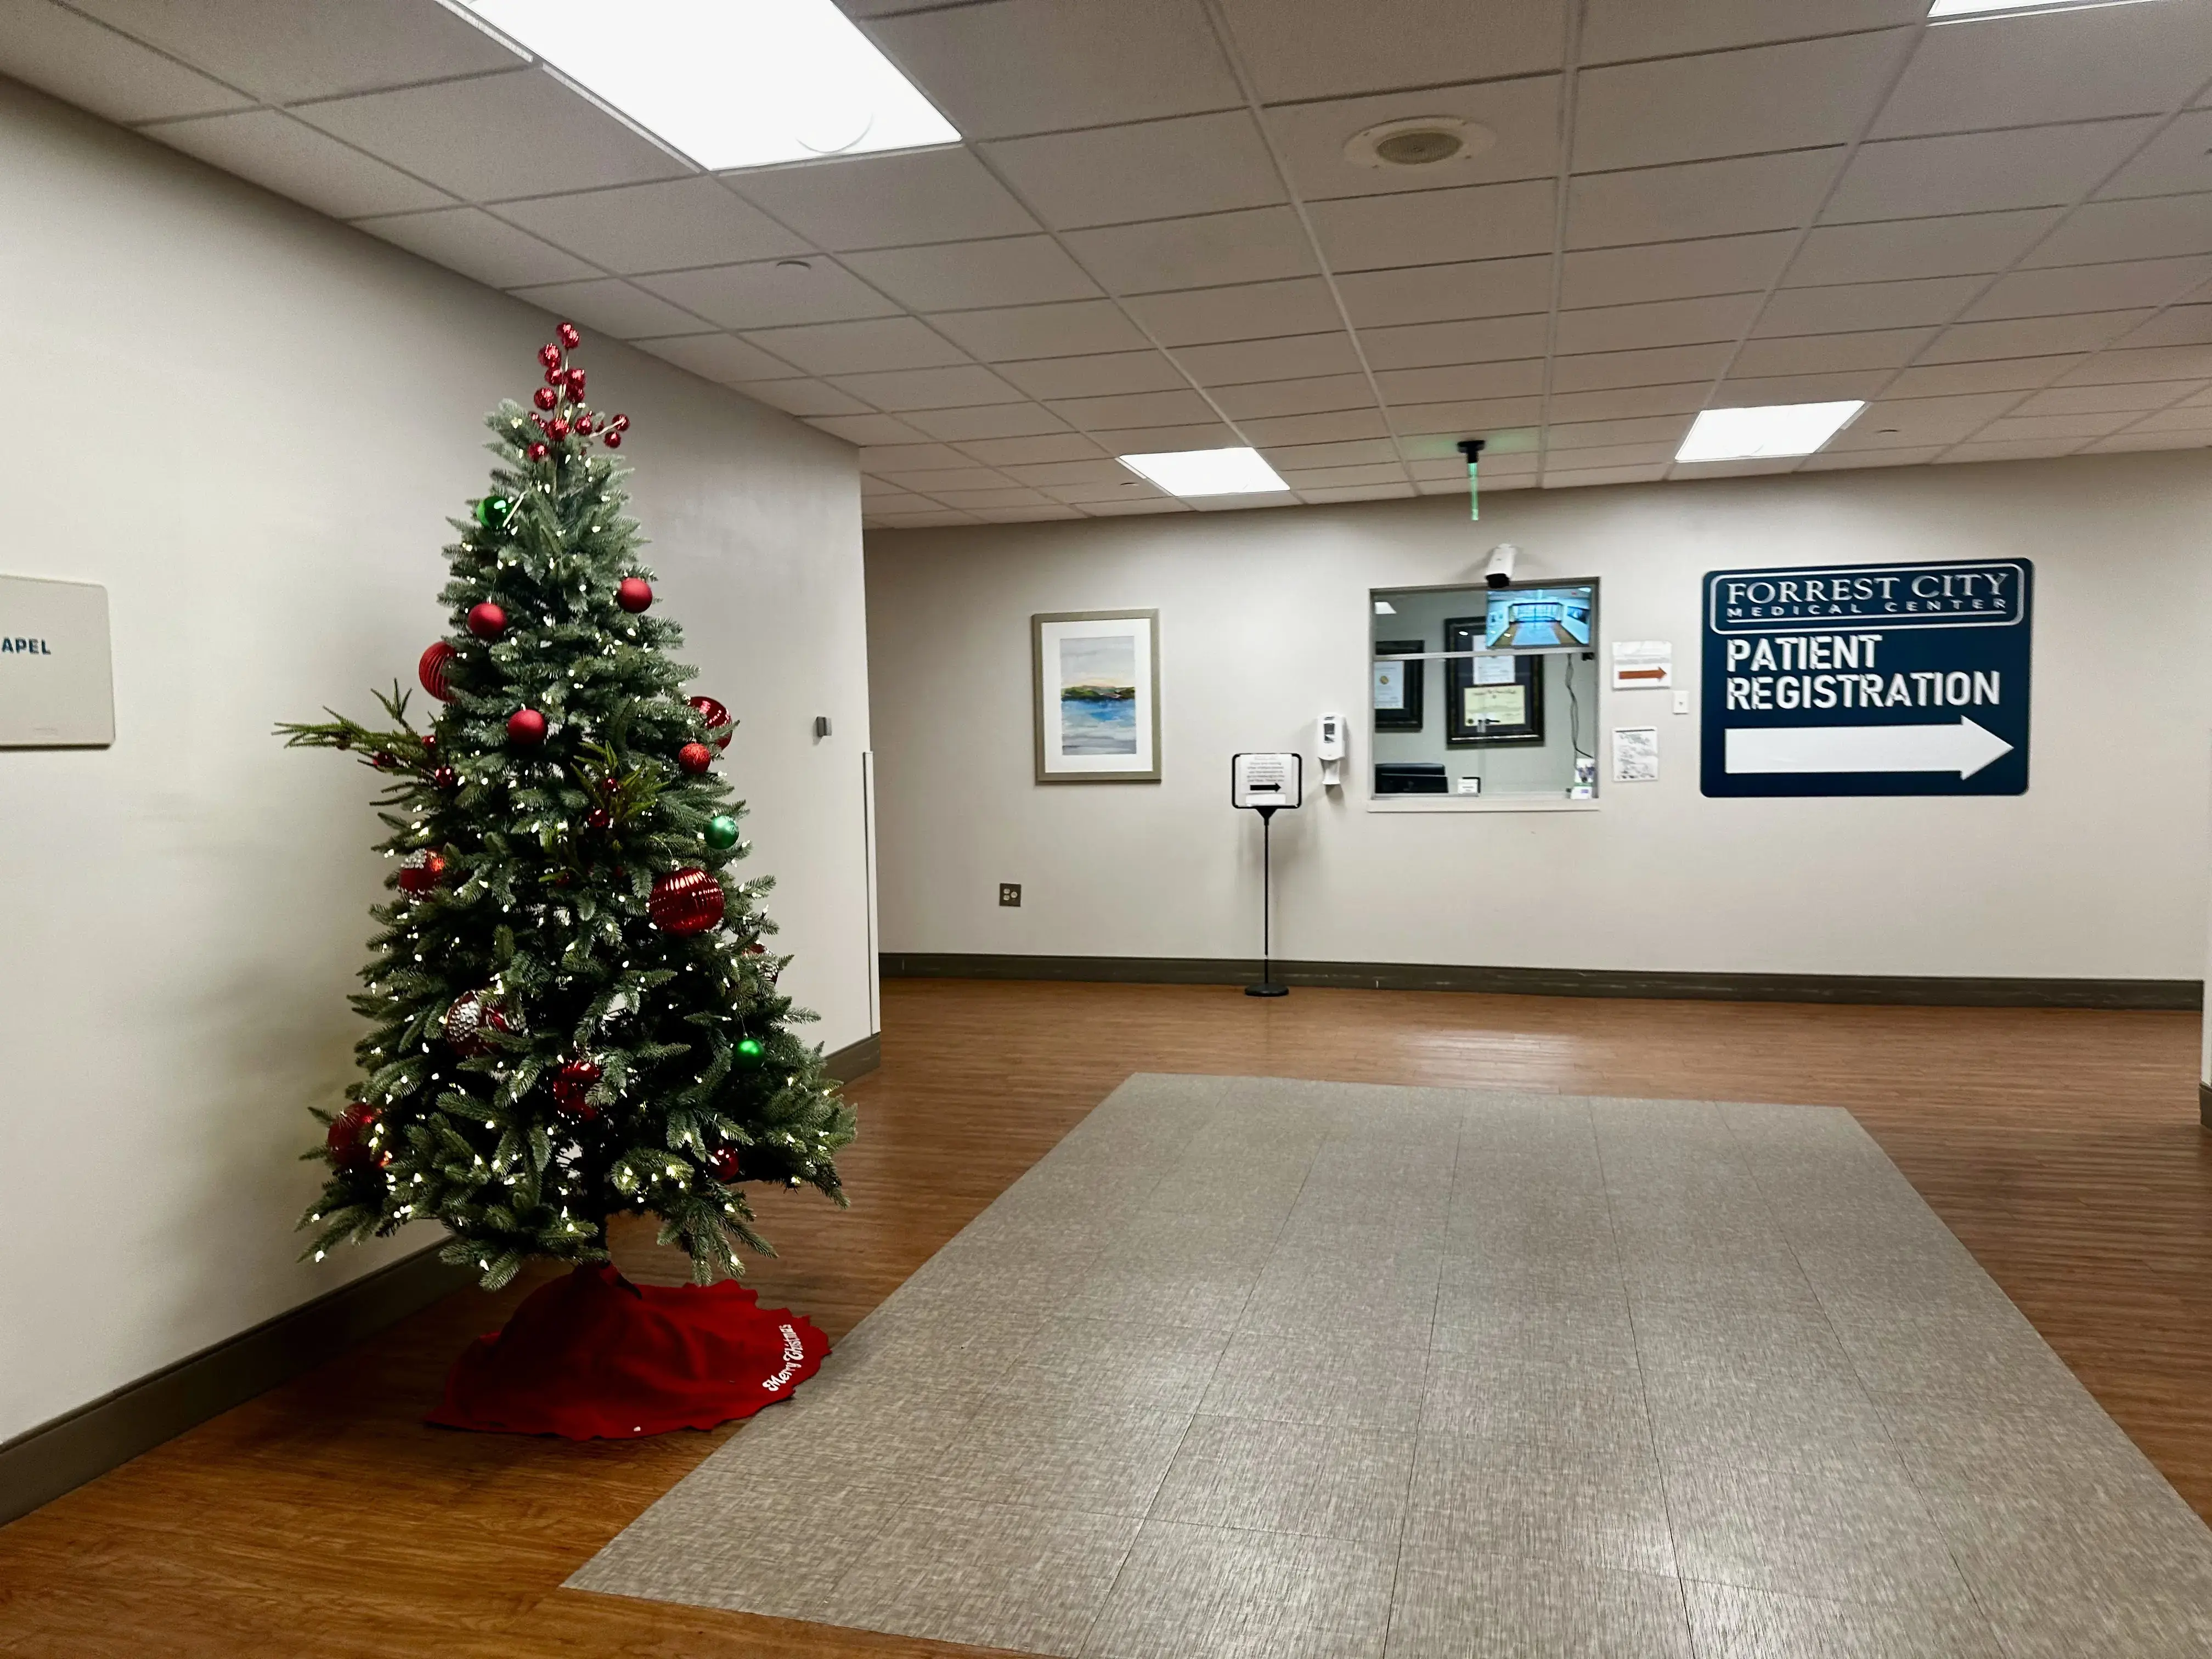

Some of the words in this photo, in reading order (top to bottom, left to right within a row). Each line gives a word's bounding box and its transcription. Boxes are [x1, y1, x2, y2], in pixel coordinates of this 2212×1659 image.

[1726, 578, 1900, 604] FORREST
[1911, 573, 2010, 598] CITY
[1726, 603, 1862, 617] MEDICAL
[1884, 599, 2007, 612] CENTER
[2, 636, 52, 655] APEL
[1726, 634, 1882, 672] PATIENT
[1725, 670, 2001, 710] REGISTRATION
[762, 1362, 802, 1391] Merry
